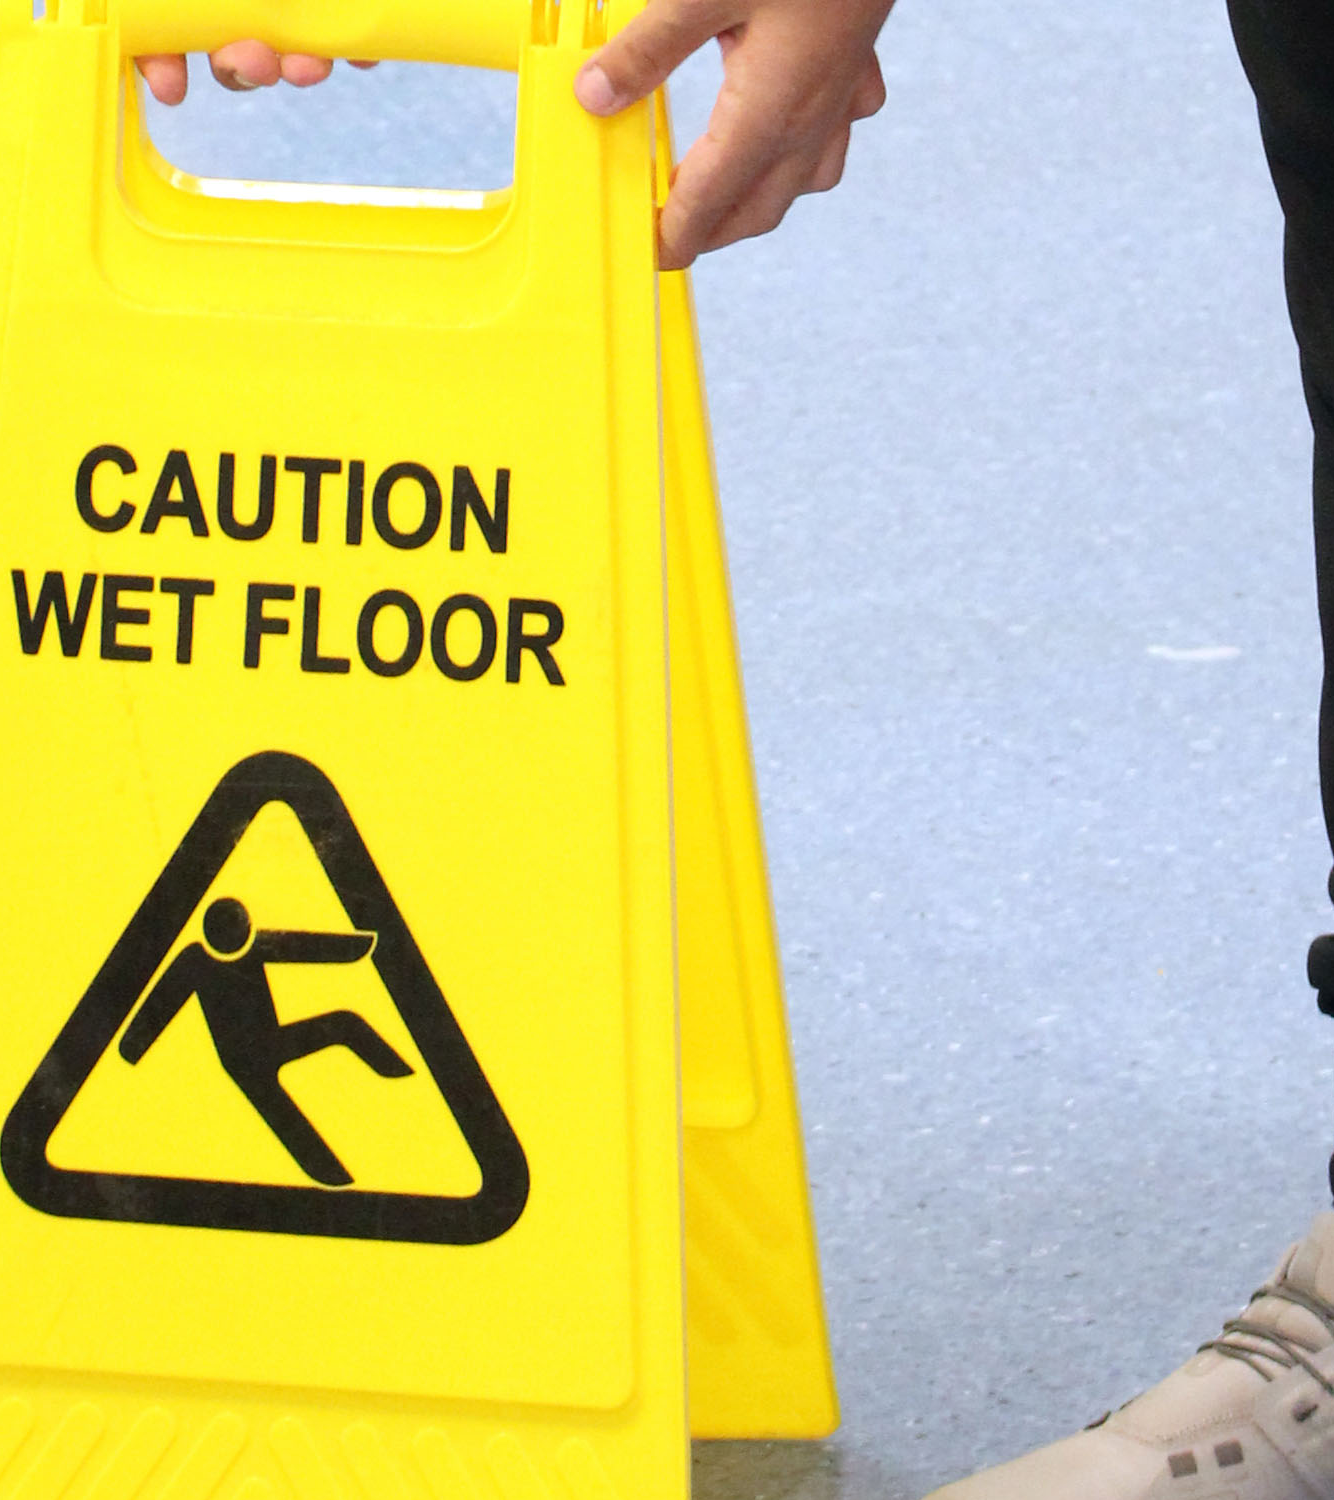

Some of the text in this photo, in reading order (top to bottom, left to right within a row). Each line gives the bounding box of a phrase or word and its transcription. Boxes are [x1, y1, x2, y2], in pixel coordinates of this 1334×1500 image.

[75, 444, 511, 554] CAUTION
[11, 569, 566, 687] WET FLOOR
